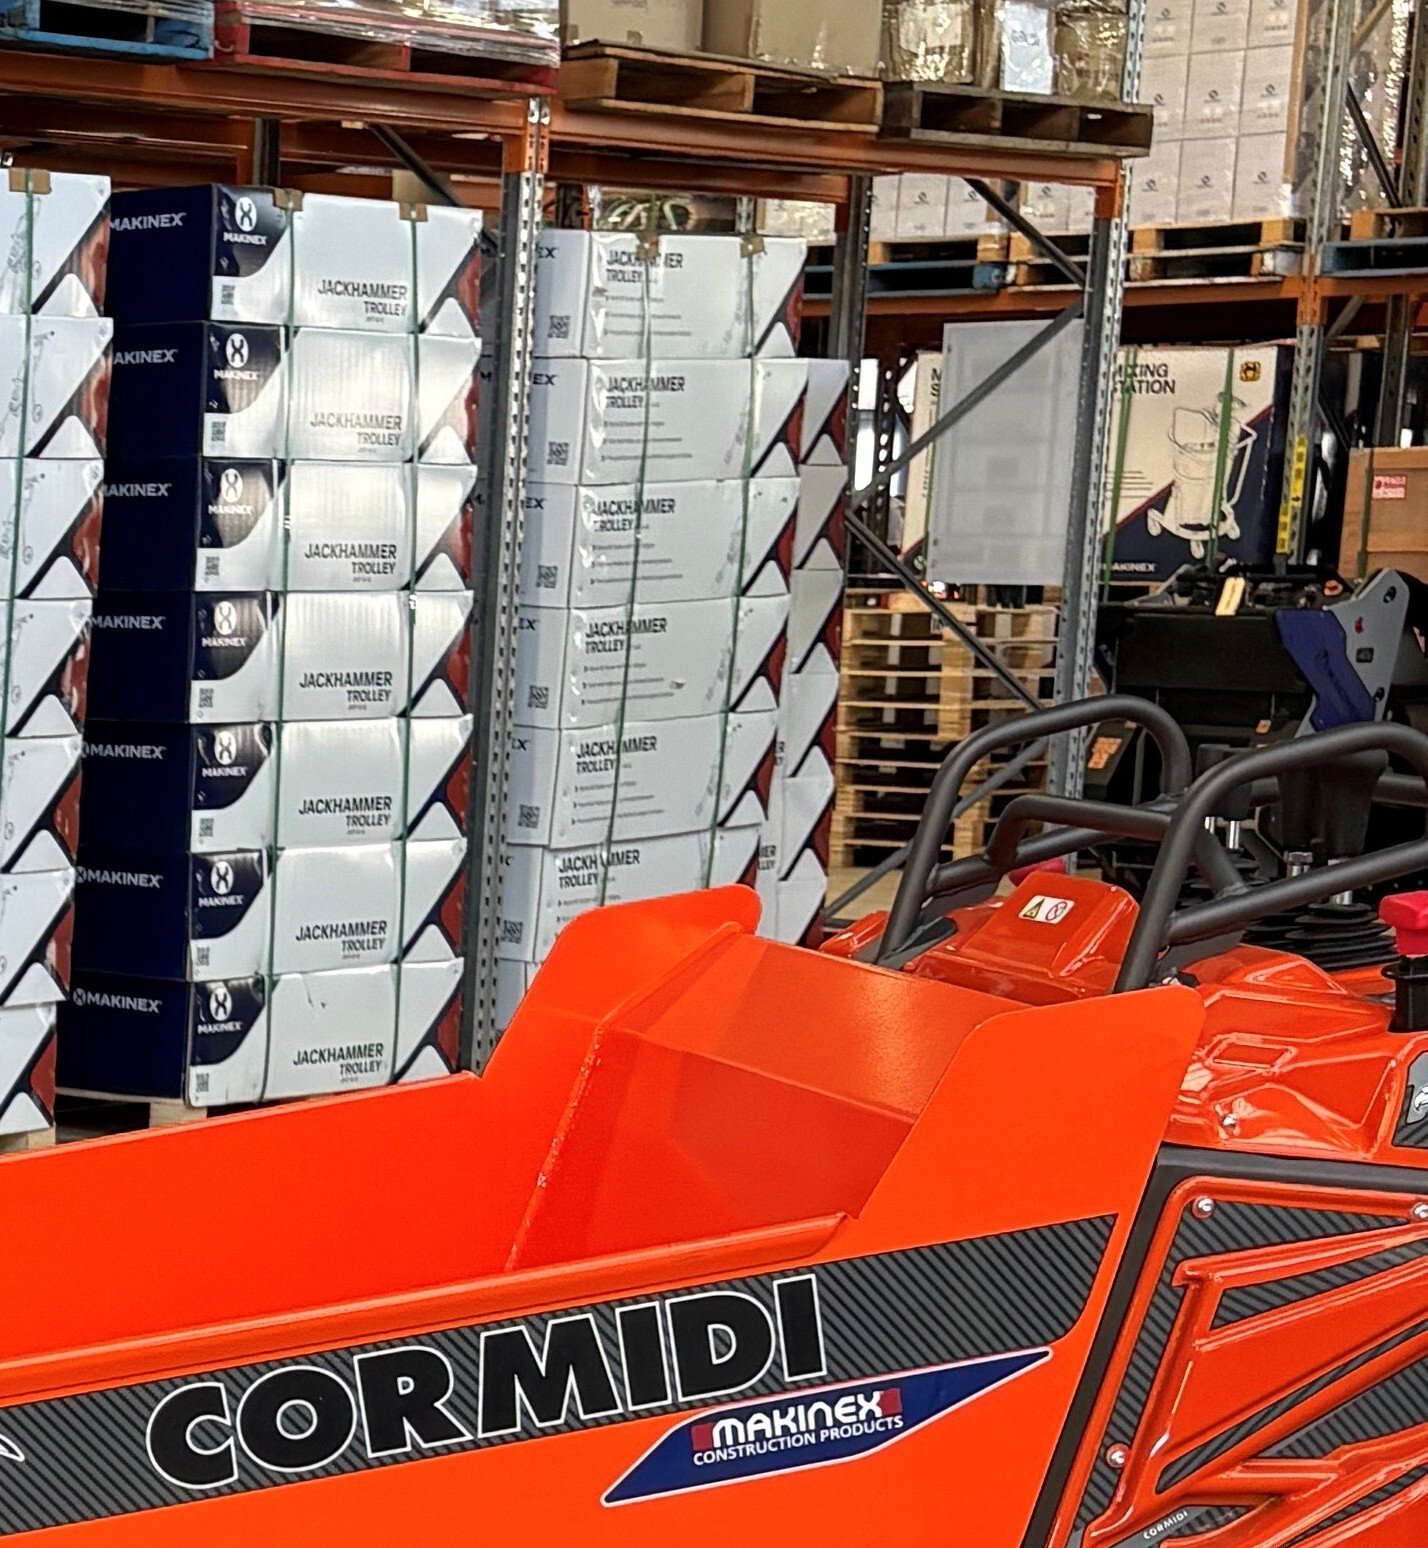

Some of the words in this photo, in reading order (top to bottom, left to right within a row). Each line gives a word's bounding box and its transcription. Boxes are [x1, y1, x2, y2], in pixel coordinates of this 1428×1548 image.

[224, 232, 267, 245] MAKINEX
[318, 279, 407, 300] JACKHAMMER
[364, 301, 407, 316] TROLLEY
[113, 349, 178, 365] AKINEX
[214, 370, 259, 380] MAKINEX
[310, 412, 402, 431] JACKHAMMER
[357, 432, 401, 446] TROLLEY
[208, 505, 253, 515] MAKINEX
[305, 543, 397, 560] JACKHAMMER
[352, 562, 396, 574] TROLLEY
[202, 637, 247, 647] MAKINEX
[300, 672, 392, 688] JACKHAMMER
[347, 690, 391, 702] TROLLEY
[90, 744, 166, 759] MAKINEX
[202, 767, 247, 777] MAKINEX
[299, 796, 392, 815] JACKHAMMER
[346, 814, 390, 827] TROLLEY
[88, 870, 163, 888] MAKINEX
[198, 895, 244, 907] MAKINEX
[296, 921, 387, 941] JACKHAMMER
[341, 938, 386, 952] TROLLEY
[87, 991, 162, 1013] MAKINEX
[197, 1021, 242, 1034] MAKINEX
[293, 1042, 384, 1065] JACKHAMMER
[340, 1060, 382, 1075] TROLLEY
[147, 1274, 827, 1490] CORMIDI
[713, 1390, 884, 1448] MAKINEX
[693, 1429, 816, 1466] CONSTRUCTION
[820, 1415, 904, 1442] PRODUCTS
[1143, 1510, 1189, 1540] CORMIDI
